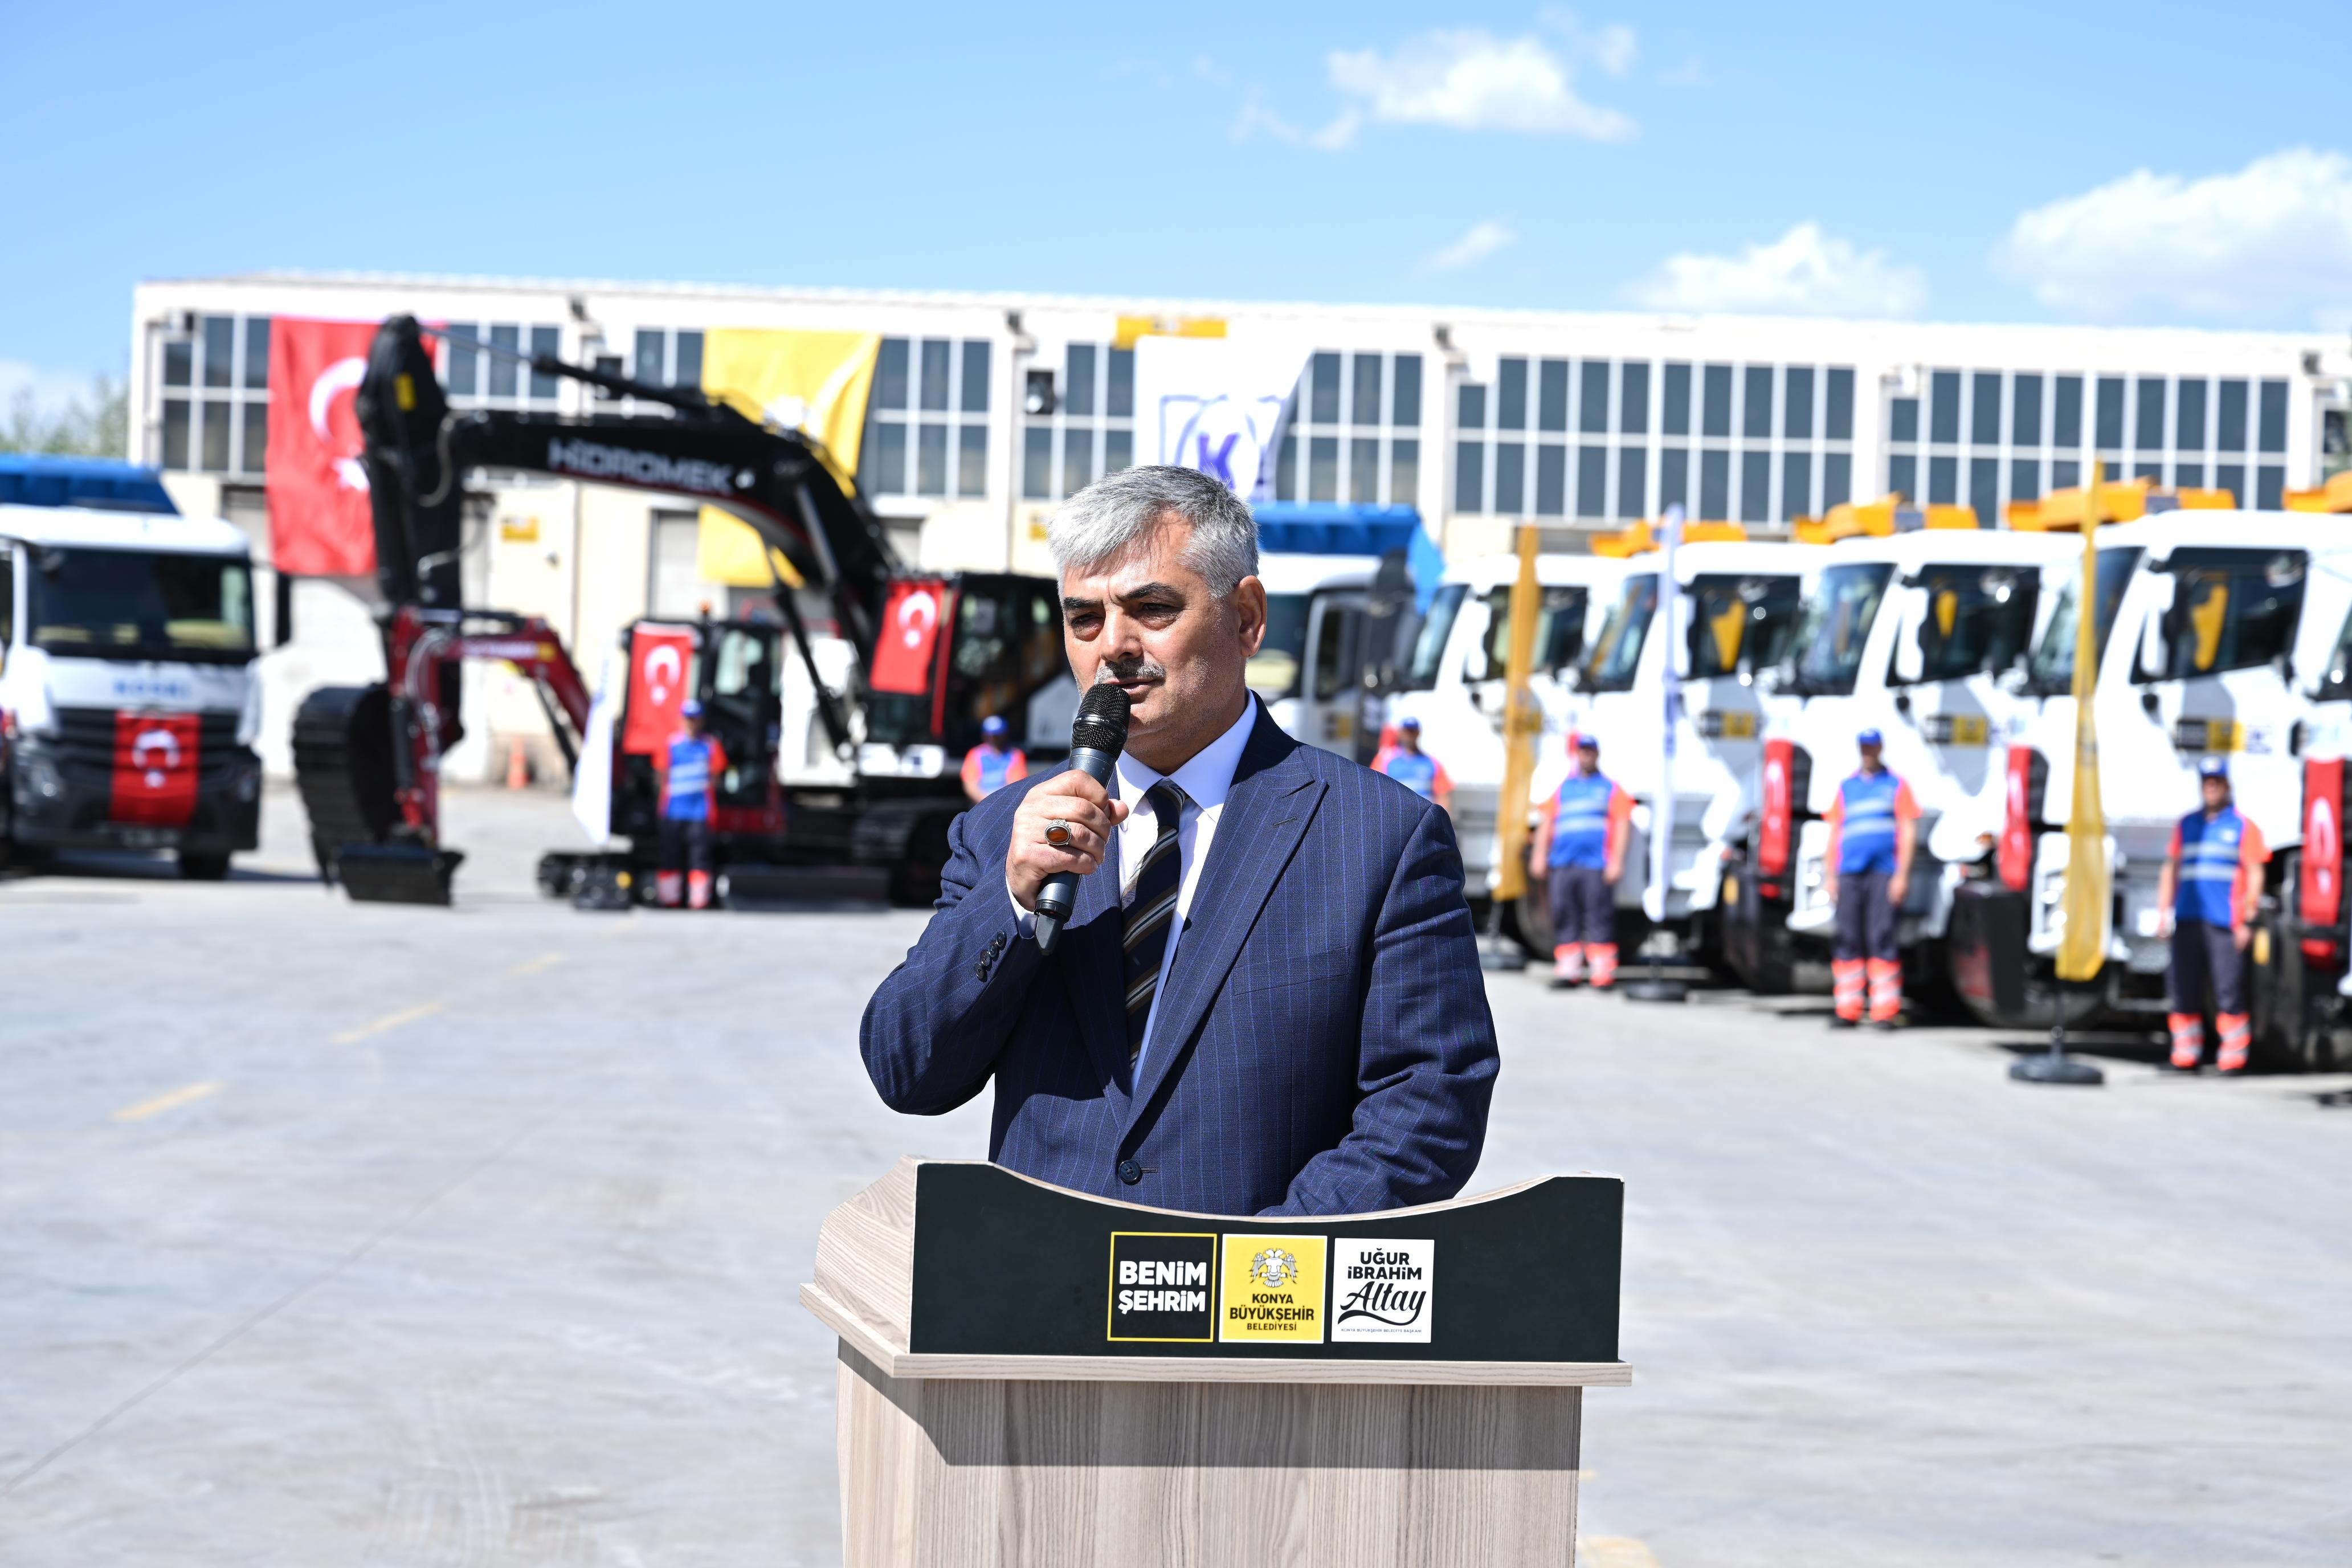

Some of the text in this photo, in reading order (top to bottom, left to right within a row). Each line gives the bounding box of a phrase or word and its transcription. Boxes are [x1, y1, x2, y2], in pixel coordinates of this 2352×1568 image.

[1360, 1248, 1410, 1265] UĞUR
[1252, 1293, 1293, 1304] KONYA
[1338, 1281, 1427, 1326] Altay
[1230, 1305, 1314, 1322] BÜYÜKŞEHİR
[1247, 1321, 1297, 1331] BELEDİYESİ
